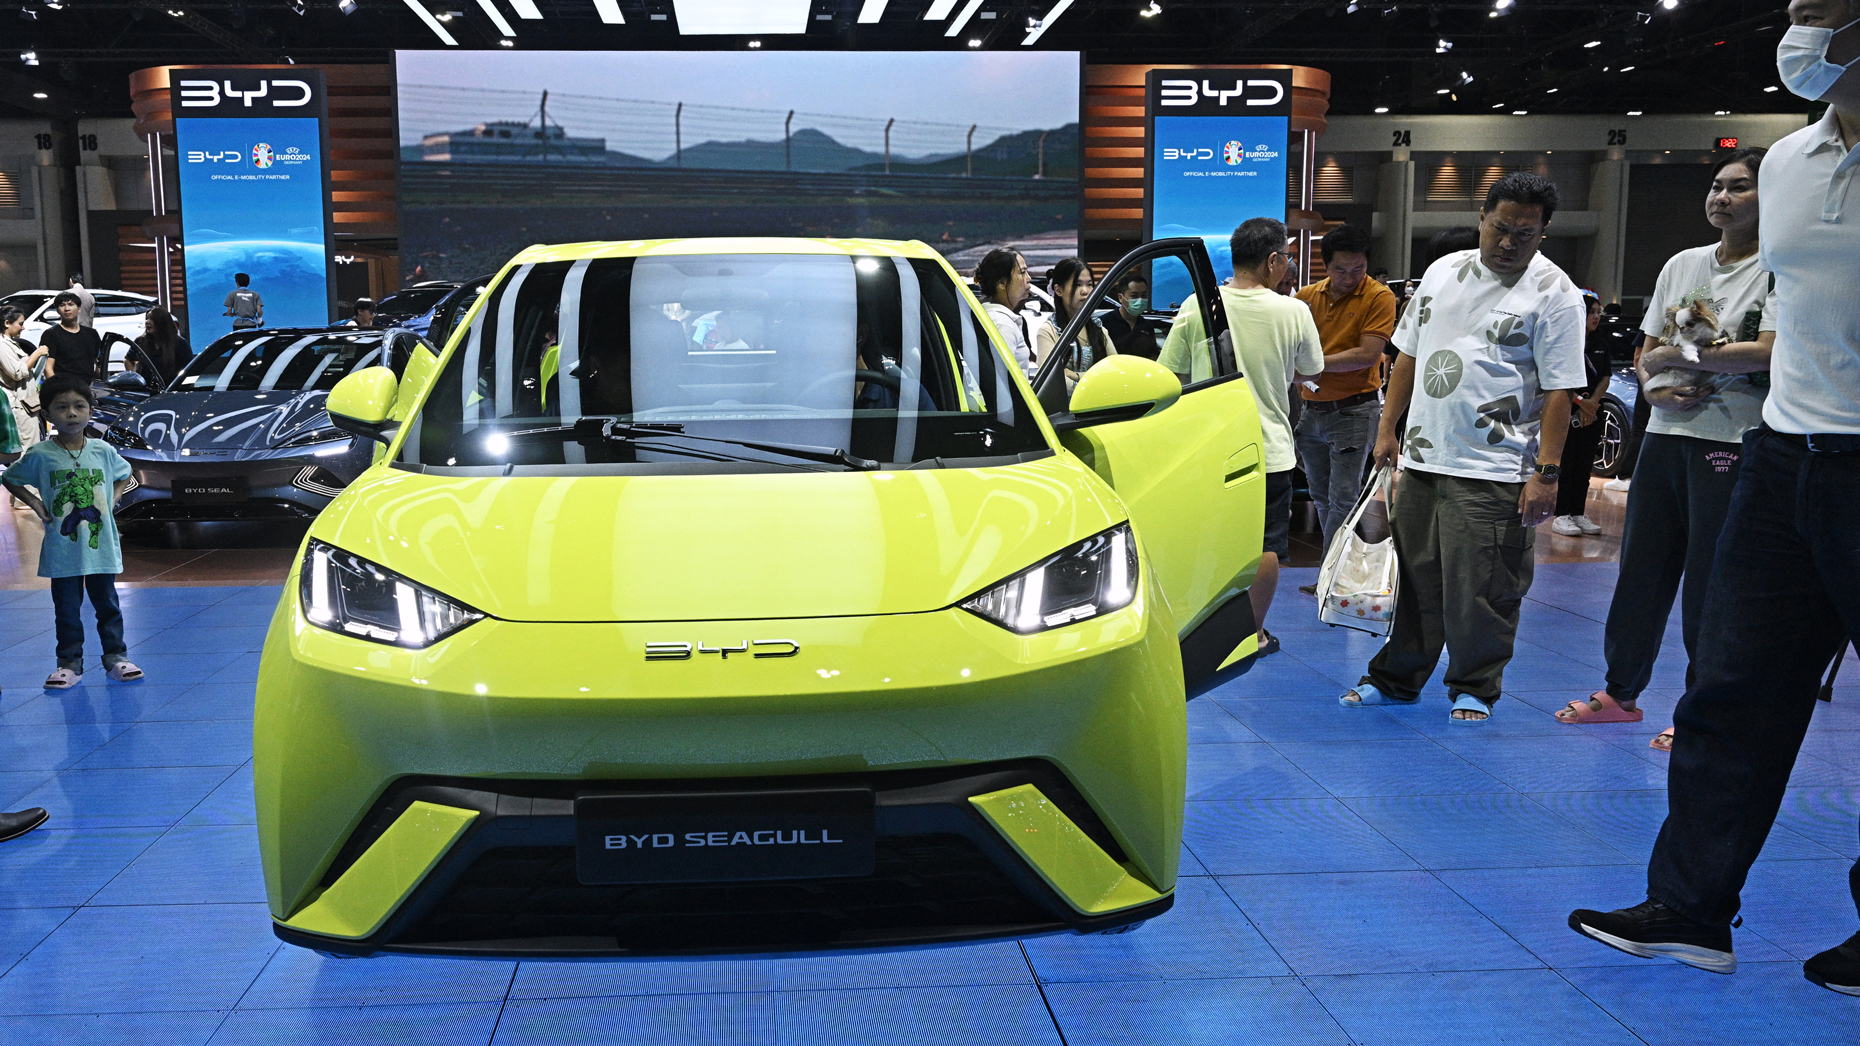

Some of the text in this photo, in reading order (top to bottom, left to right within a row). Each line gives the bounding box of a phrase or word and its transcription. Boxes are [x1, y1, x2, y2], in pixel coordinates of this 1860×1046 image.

[180, 80, 312, 107] BYD
[1161, 79, 1284, 106] BYD
[34, 133, 53, 150] 18
[80, 134, 98, 151] 18
[1392, 130, 1411, 147] 24
[1607, 129, 1627, 146] 25
[187, 151, 242, 163] BYD
[1163, 148, 1214, 160] BYD
[1705, 451, 1739, 461] AMERICAN
[645, 639, 800, 661] BYD
[604, 829, 844, 850] BYD SEAGULL
